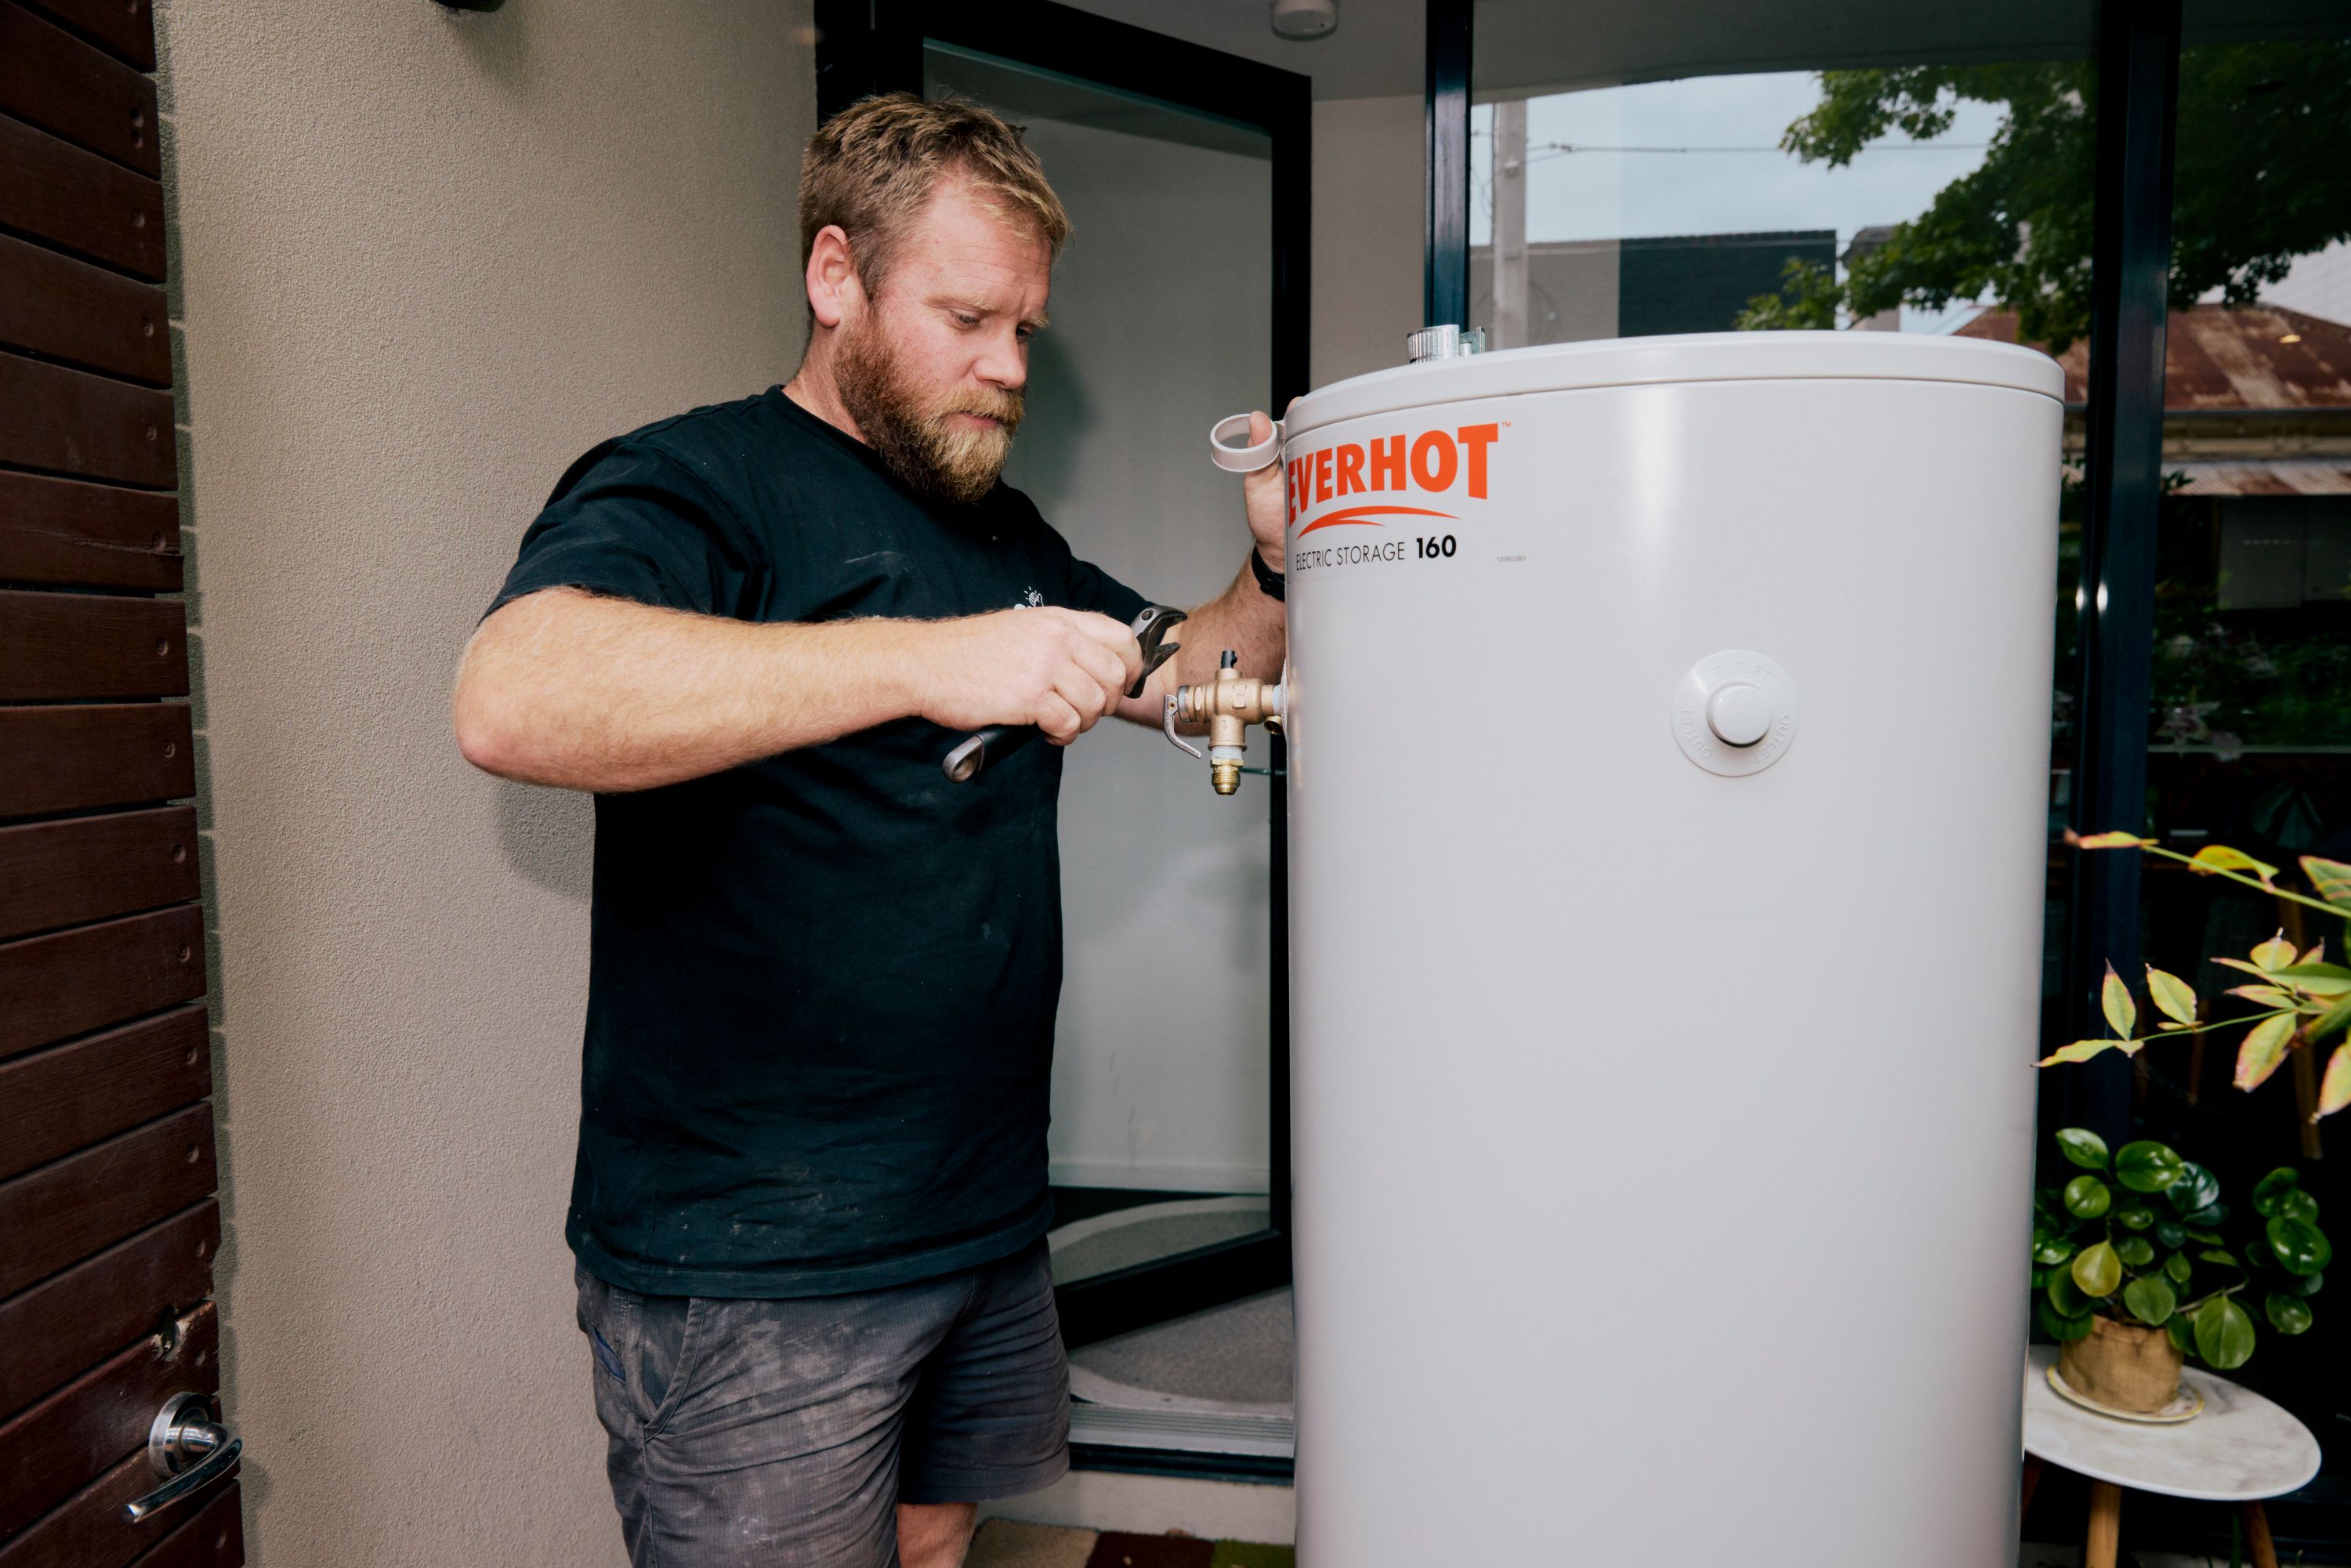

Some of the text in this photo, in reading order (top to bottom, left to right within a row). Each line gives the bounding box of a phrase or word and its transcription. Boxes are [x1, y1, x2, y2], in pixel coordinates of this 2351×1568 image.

[1288, 422, 1499, 527] EVERHOT
[1295, 534, 1458, 571] ELECTRIC STORAGE 160
